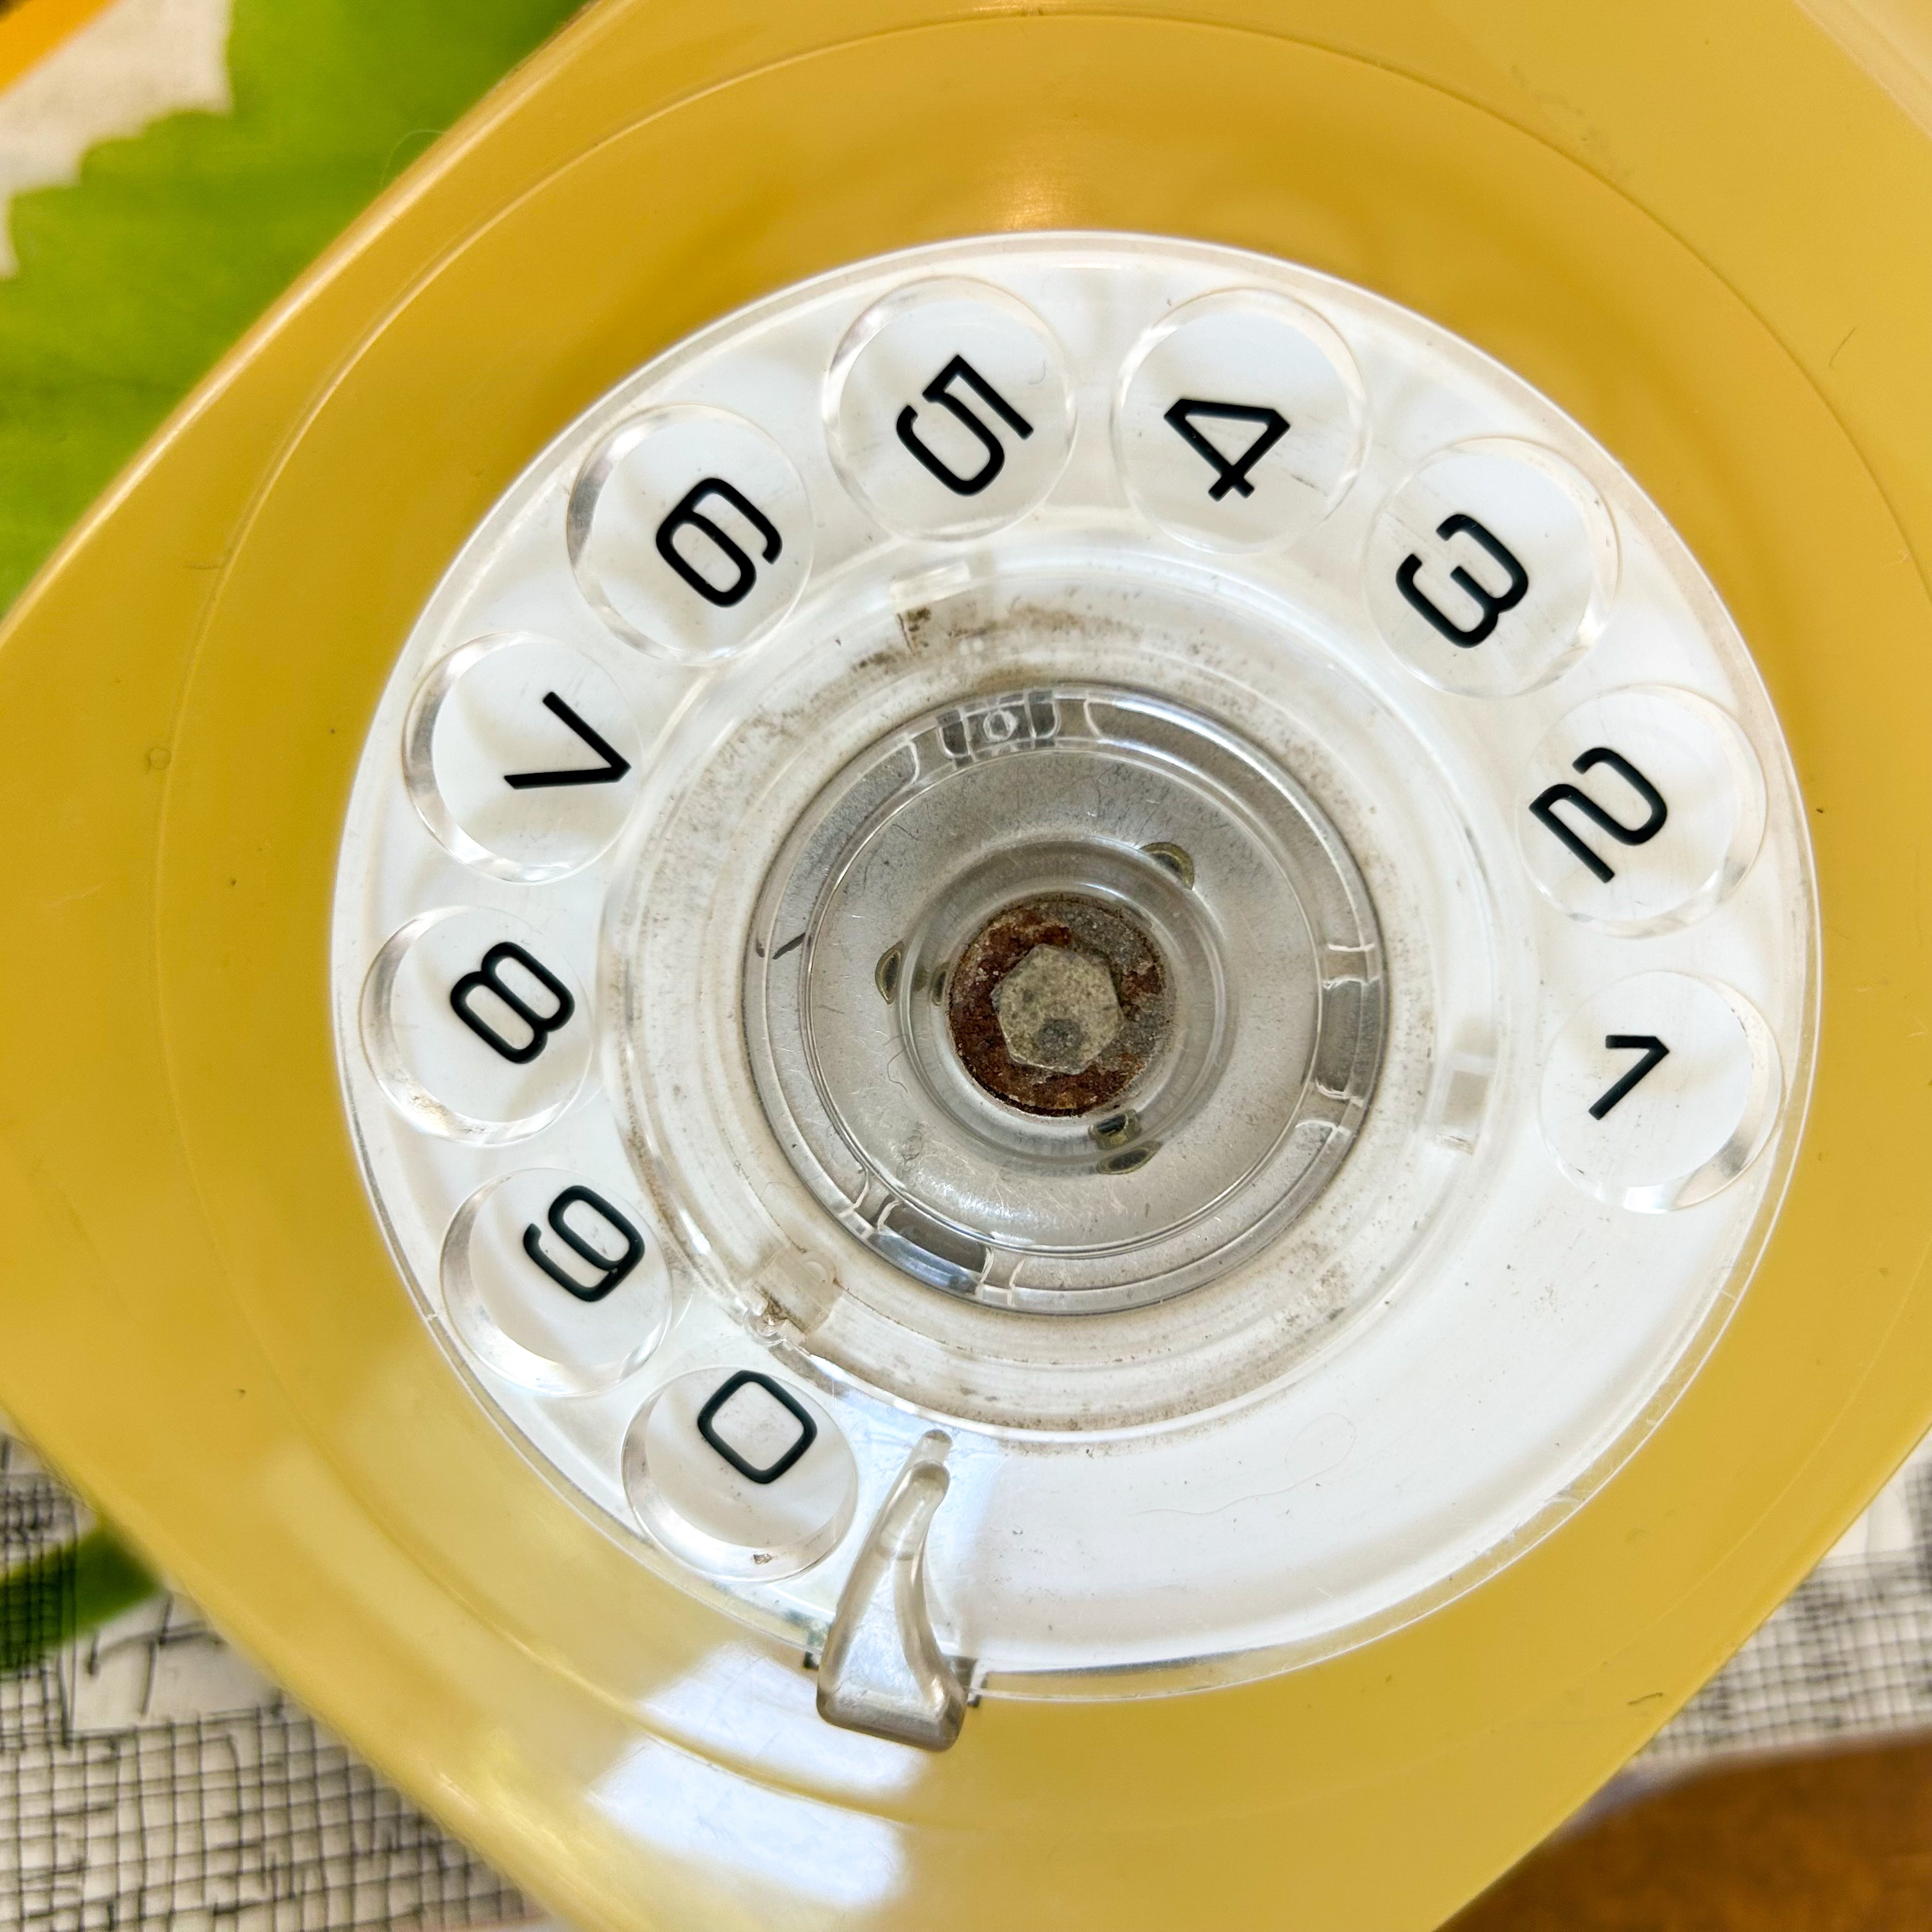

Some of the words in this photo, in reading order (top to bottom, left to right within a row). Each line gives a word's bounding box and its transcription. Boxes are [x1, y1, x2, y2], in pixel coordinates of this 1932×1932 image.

[895, 353, 1035, 497] 5
[1163, 397, 1292, 502] 4
[654, 476, 783, 608] 6
[1395, 512, 1530, 649] 3
[503, 691, 632, 790] 7
[1528, 746, 1669, 884] 2
[448, 940, 576, 1065] 8
[1588, 1034, 1671, 1121] 1
[521, 1184, 646, 1304] 9
[696, 1369, 818, 1486] 0
